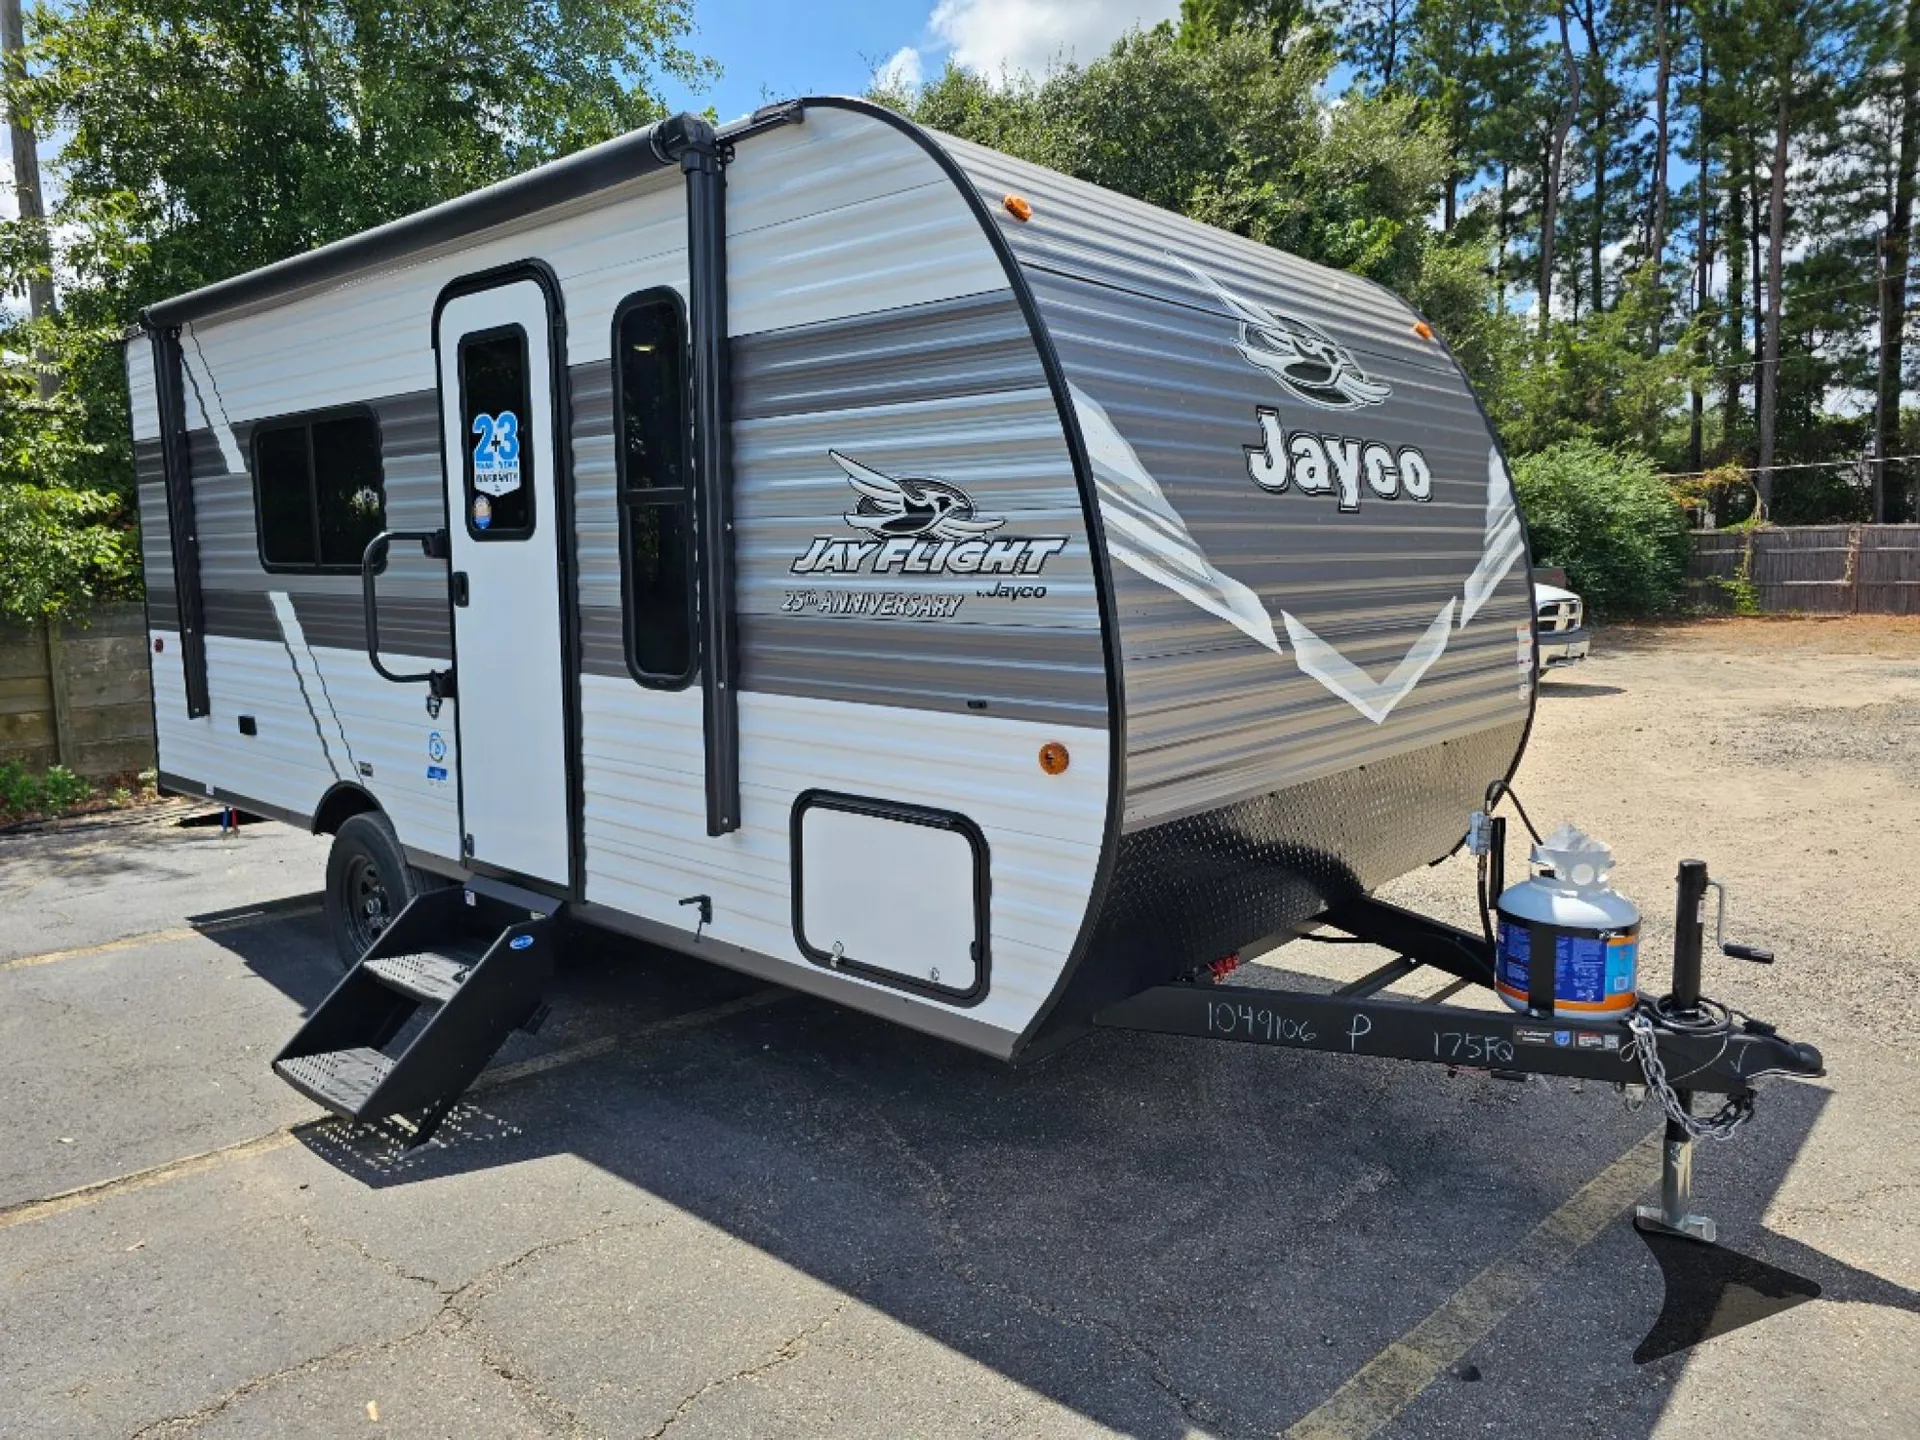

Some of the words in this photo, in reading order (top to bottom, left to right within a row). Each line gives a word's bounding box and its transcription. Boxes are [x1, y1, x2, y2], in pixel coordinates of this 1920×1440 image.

[1242, 405, 1434, 514] Jayco
[791, 535, 879, 576] JAY
[873, 535, 1072, 577] FLIGHT
[817, 590, 965, 619] ANNIVERSARY
[988, 582, 1048, 601] Jayco
[1208, 1001, 1317, 1041] 1049106
[1346, 1013, 1372, 1051] P
[1433, 1031, 1514, 1062] 175FQ
